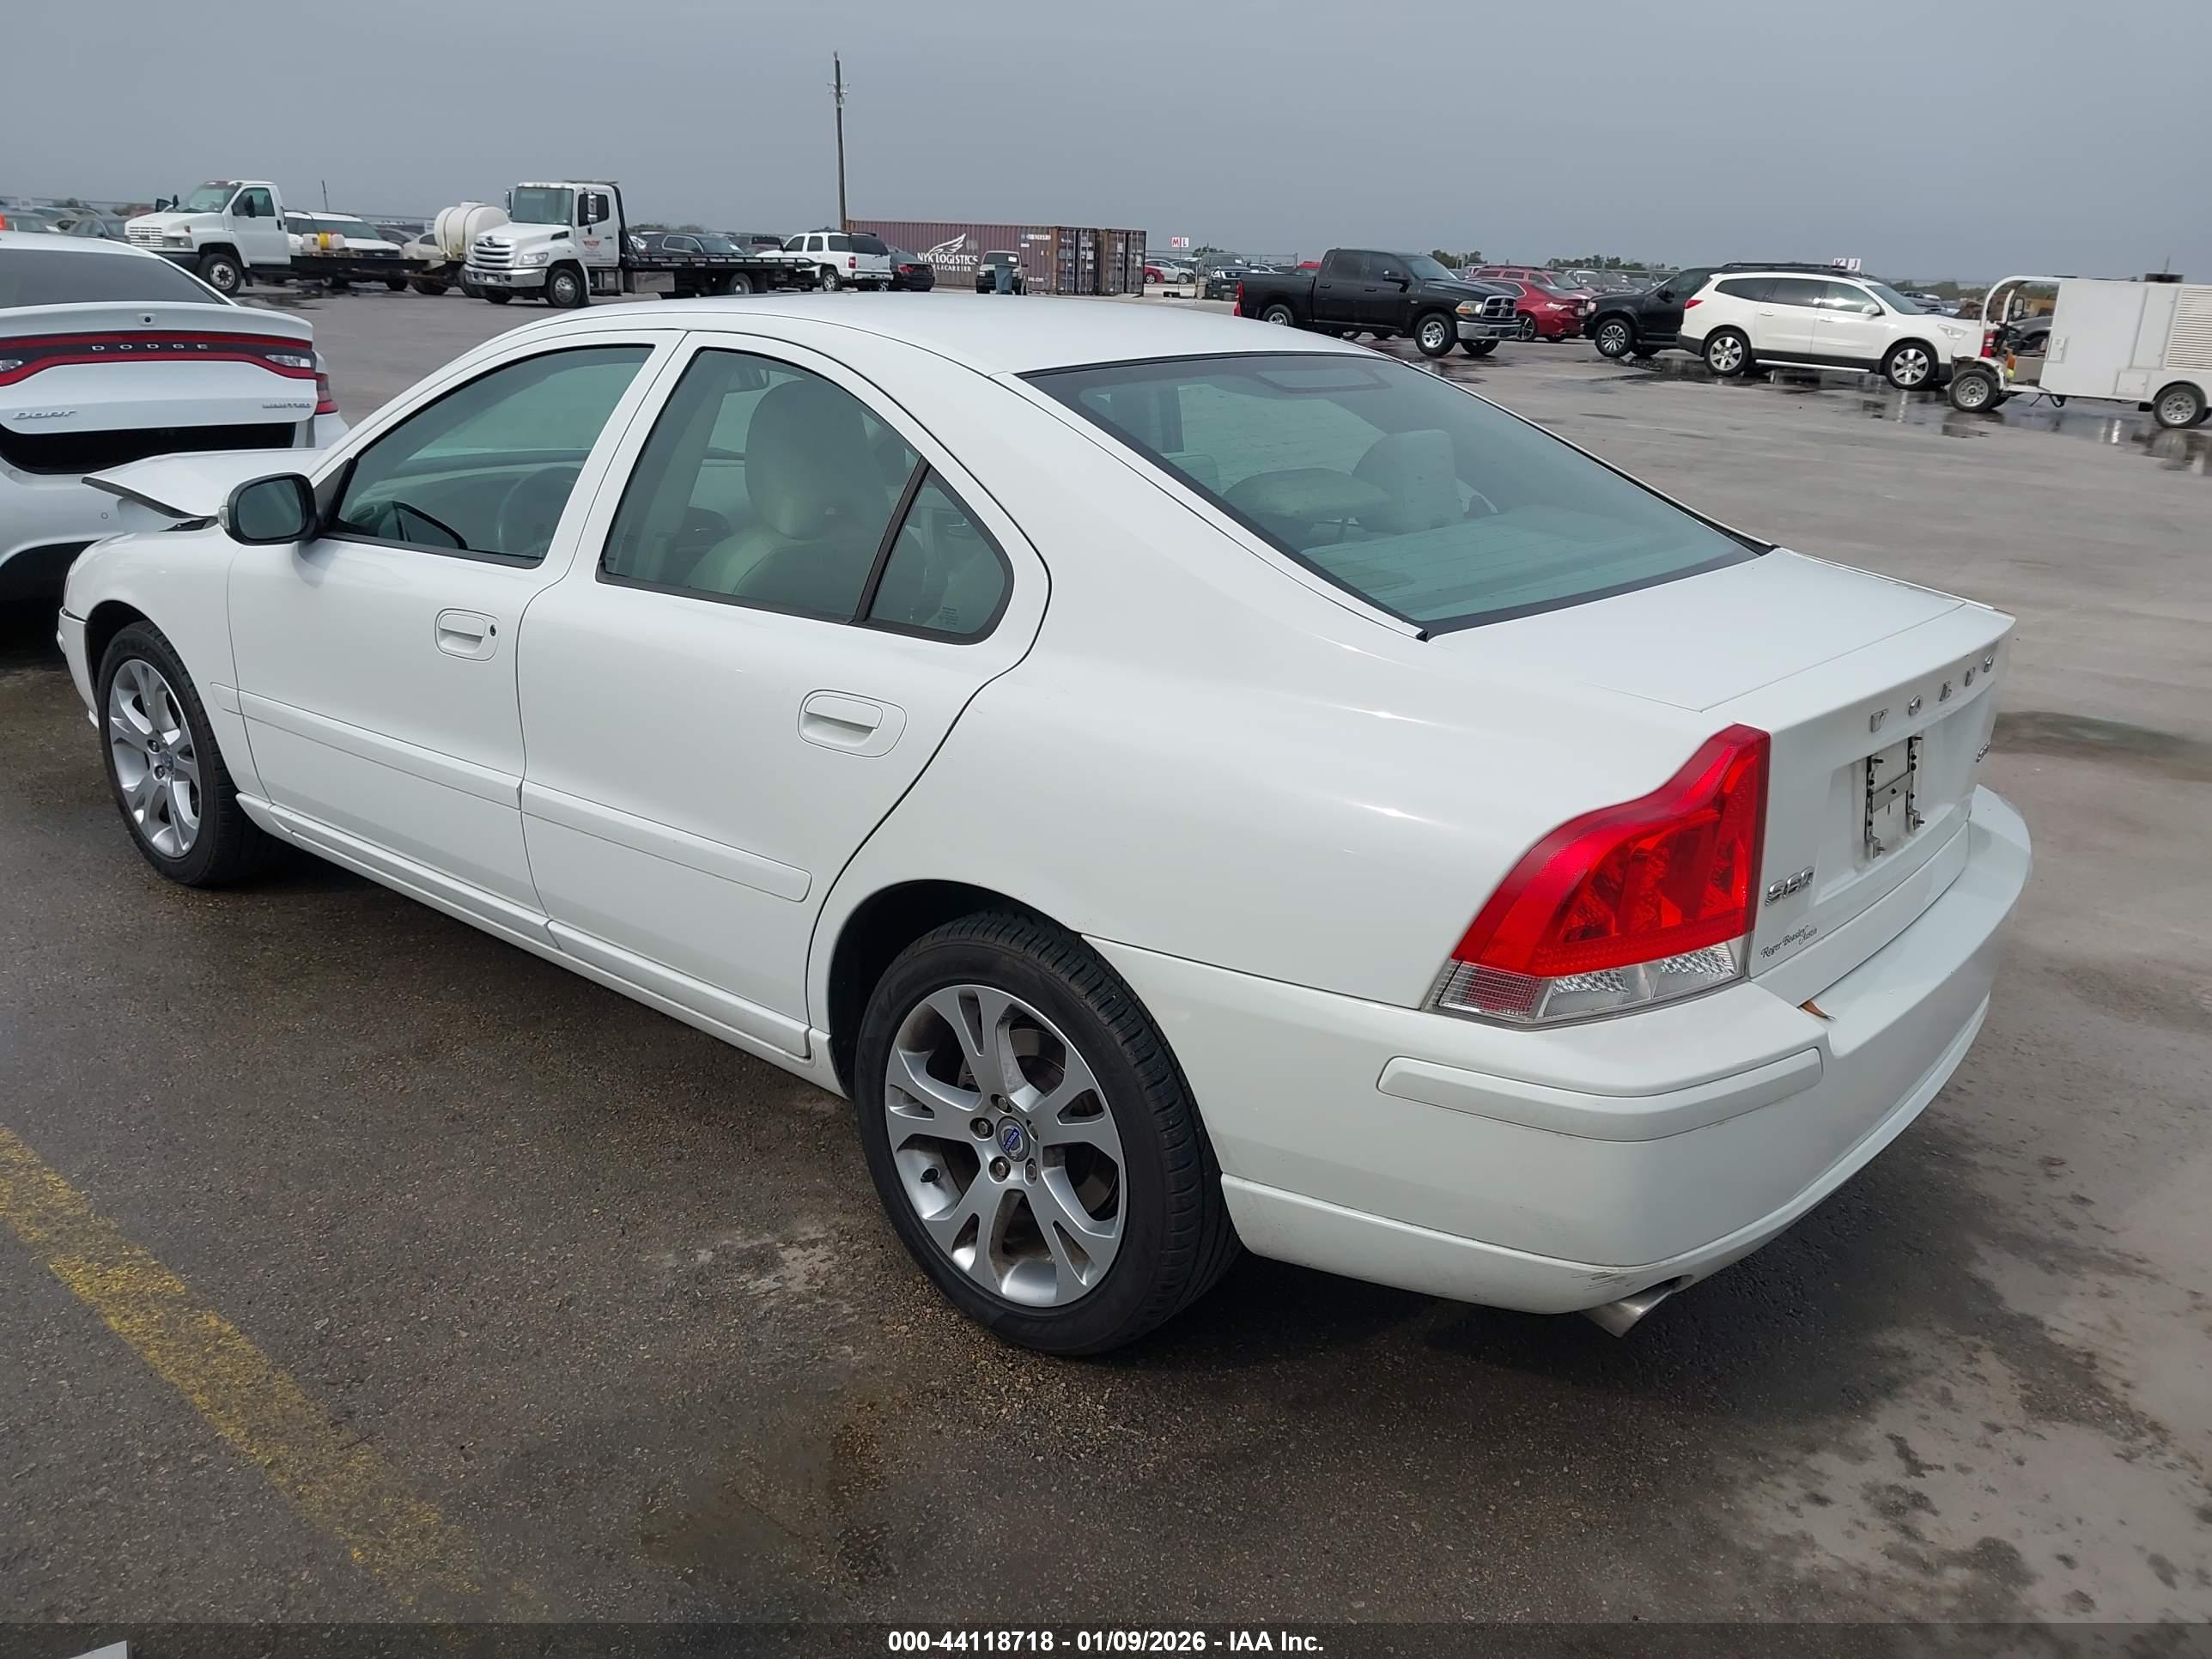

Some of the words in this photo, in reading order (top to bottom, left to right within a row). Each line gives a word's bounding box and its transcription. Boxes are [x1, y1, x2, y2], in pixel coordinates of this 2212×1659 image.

[917, 252, 934, 263] NYK
[935, 253, 978, 264] LOGISTICS
[1850, 259, 1858, 270] J
[91, 343, 208, 352] DODGE
[1869, 653, 1994, 733] VOLVO
[1765, 866, 1815, 908] S60
